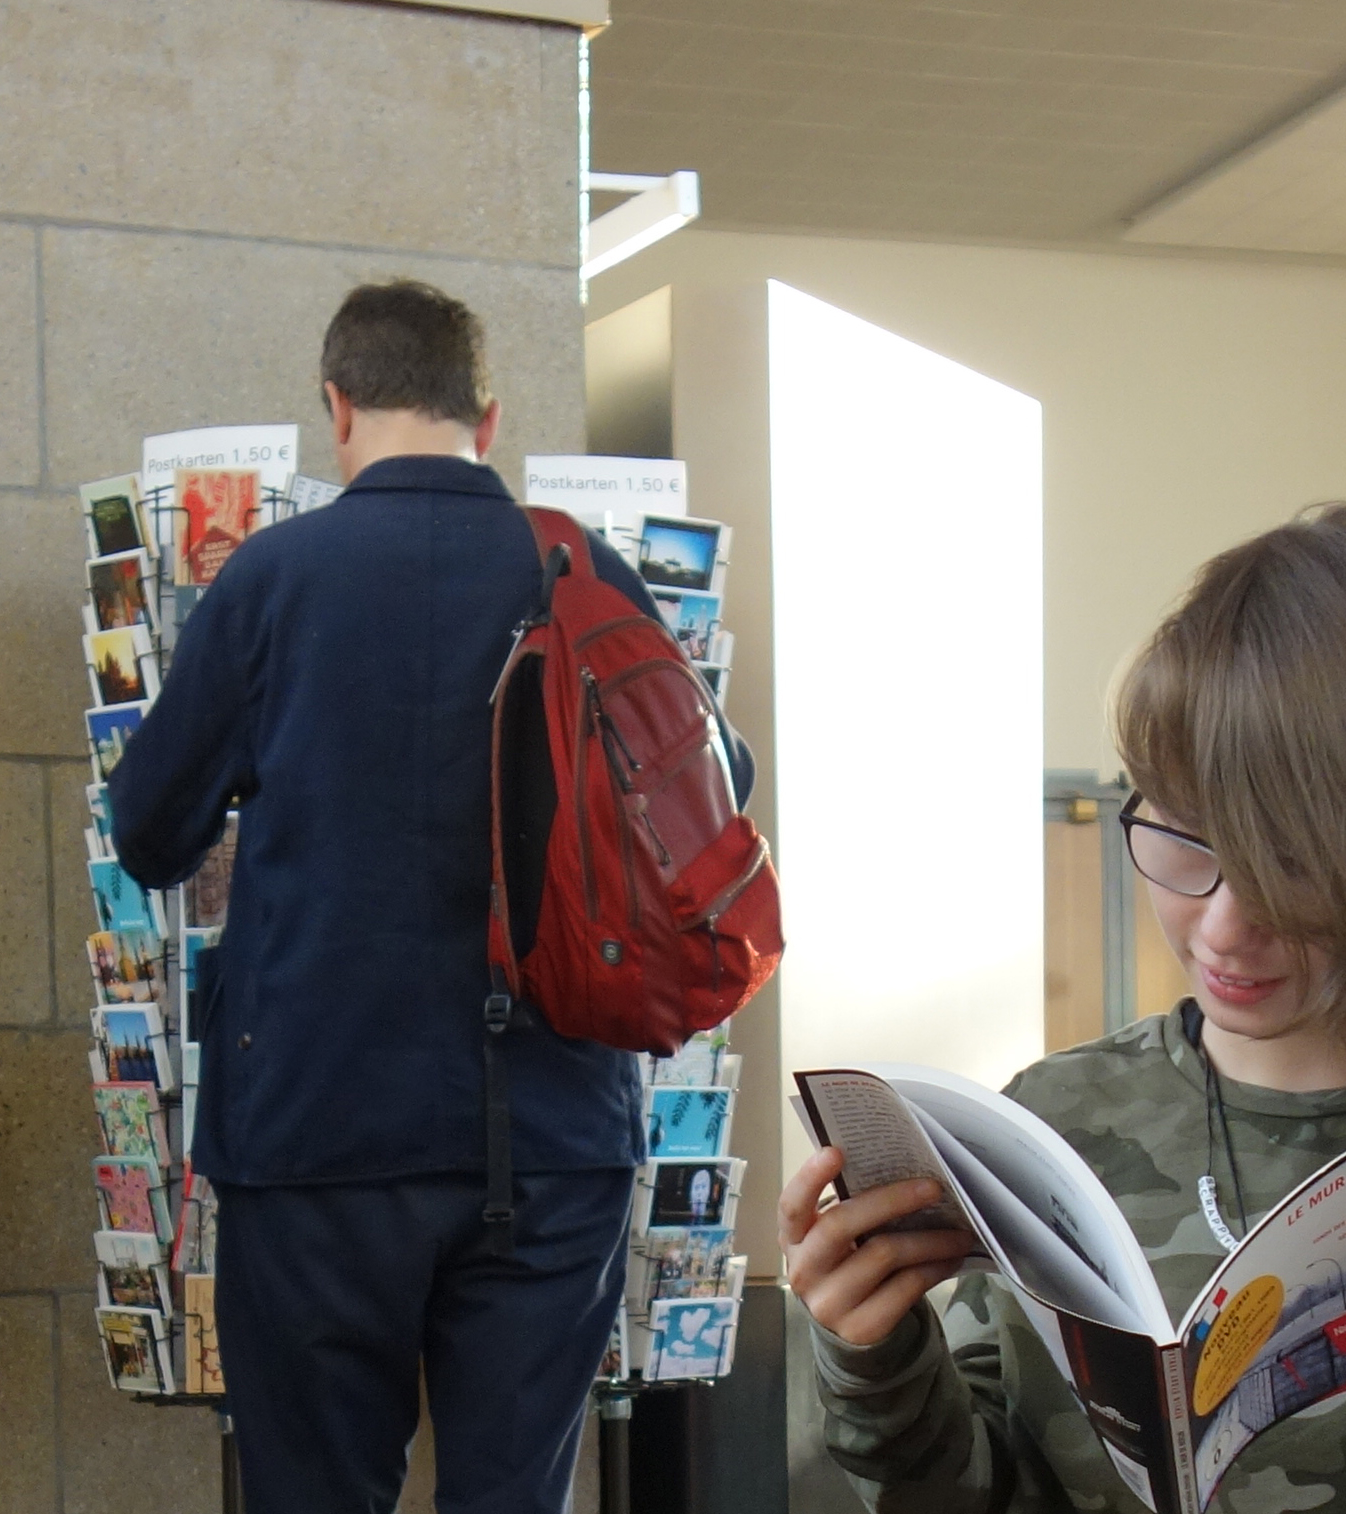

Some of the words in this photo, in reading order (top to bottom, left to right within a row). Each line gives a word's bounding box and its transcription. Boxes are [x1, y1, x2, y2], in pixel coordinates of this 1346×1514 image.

[148, 451, 225, 474] Postkarten
[232, 445, 272, 465] 1,50
[278, 444, 290, 461] €
[528, 474, 619, 491] Postkarten
[626, 477, 664, 493] 1,50
[669, 478, 681, 493] €
[1287, 1206, 1305, 1227] LE
[1308, 1176, 1345, 1209] MUR
[1217, 1315, 1240, 1351] DVD
